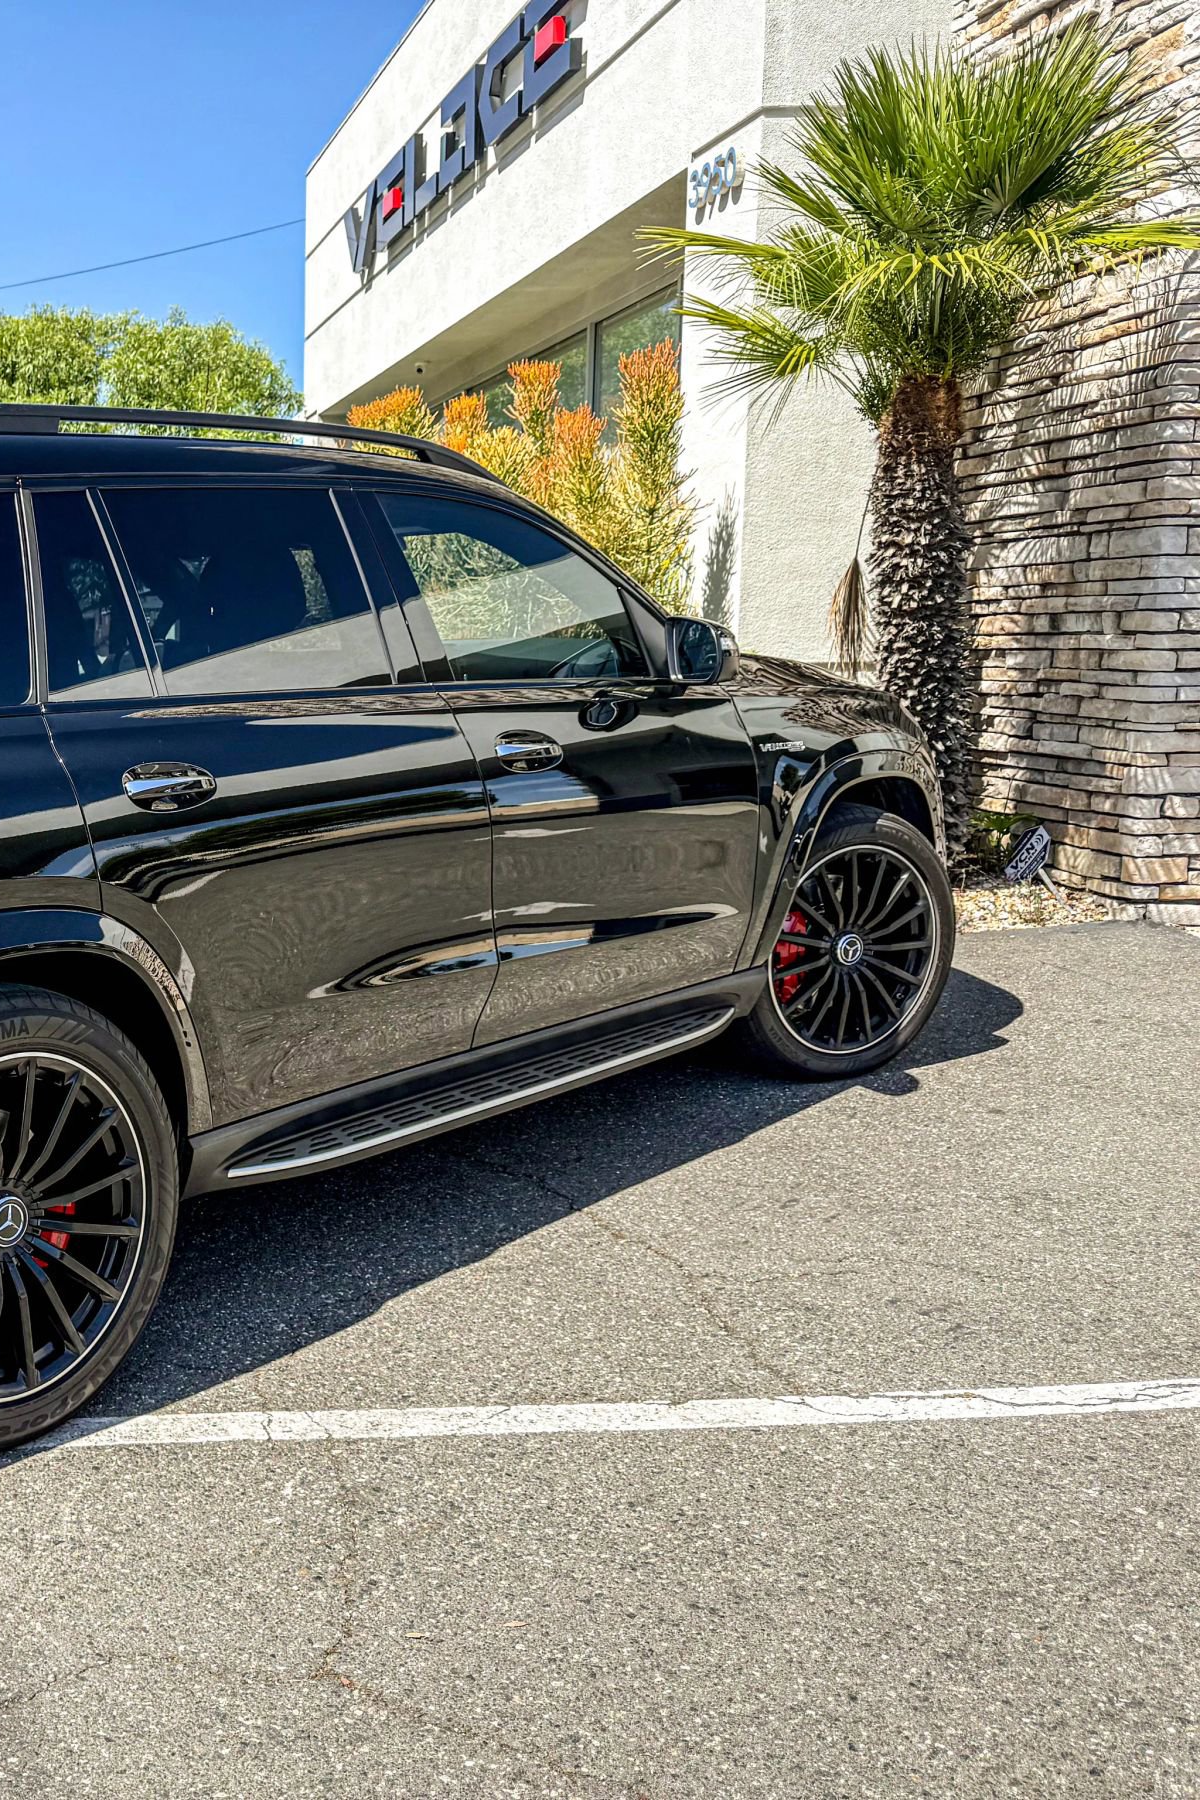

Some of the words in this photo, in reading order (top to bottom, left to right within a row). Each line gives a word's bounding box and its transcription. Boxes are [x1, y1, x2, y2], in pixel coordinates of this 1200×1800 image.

[344, 0, 585, 274] VELOCE
[689, 147, 738, 208] 3950
[1010, 842, 1036, 870] VCN
